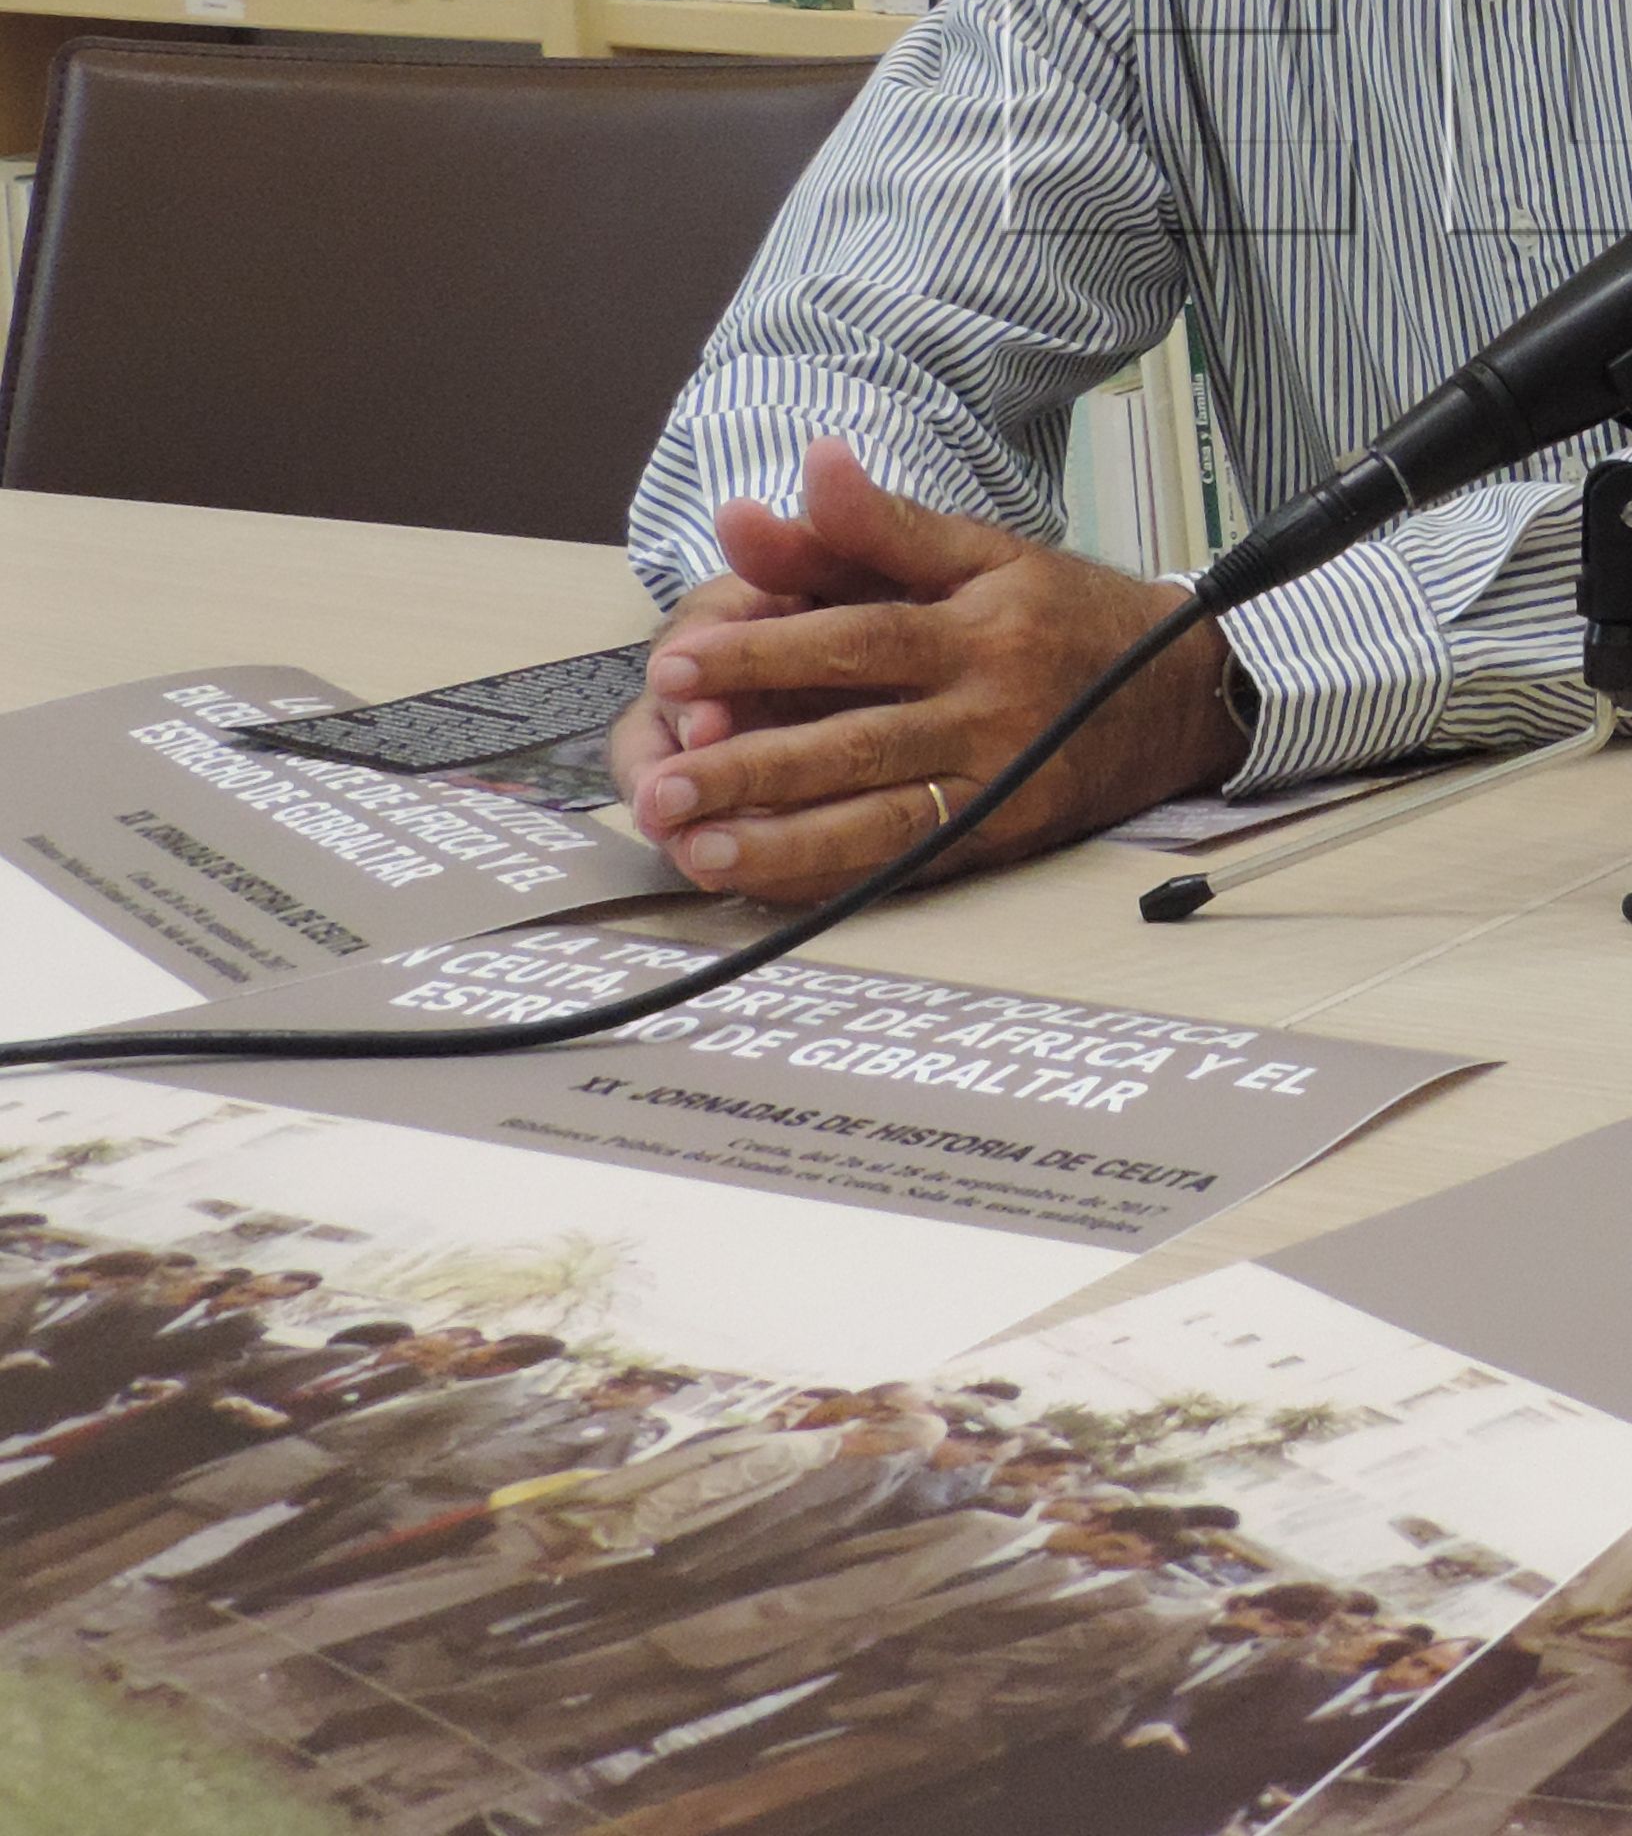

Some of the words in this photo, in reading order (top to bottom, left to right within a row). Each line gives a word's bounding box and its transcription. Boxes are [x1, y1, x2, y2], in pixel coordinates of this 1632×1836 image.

[441, 950, 630, 1001] CEUTA,
[846, 1007, 949, 1043] DE
[933, 1020, 1175, 1075] ÁFRICA
[1186, 1054, 1245, 1081] Y
[1233, 1062, 1320, 1097] EL
[512, 931, 600, 957] LA
[963, 989, 1262, 1050] POLÍTICA
[690, 1020, 797, 1059] DE
[788, 1038, 1150, 1114] GIBRALTAR
[569, 1075, 631, 1096] XX
[629, 1085, 820, 1129] JORNADAS
[812, 1113, 873, 1136] DE
[873, 1122, 1037, 1165] HISTORIA
[1043, 1149, 1098, 1173] DE
[1098, 1158, 1219, 1195] CEUTA
